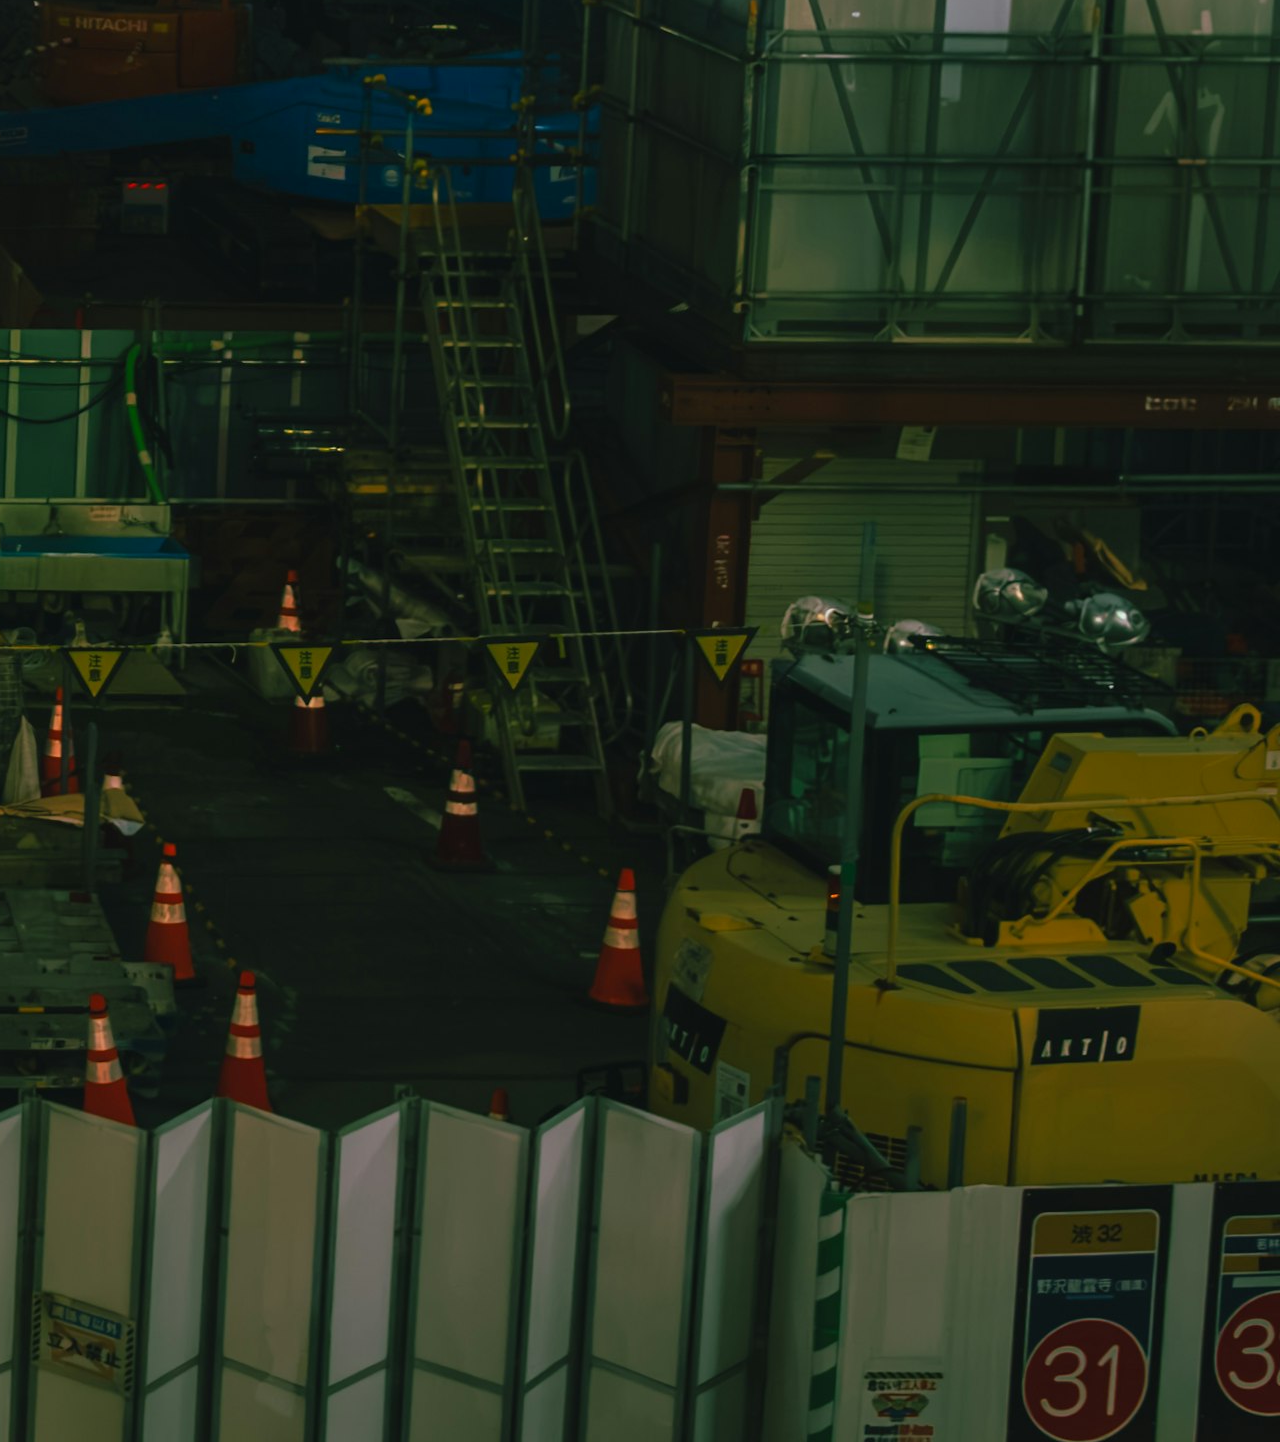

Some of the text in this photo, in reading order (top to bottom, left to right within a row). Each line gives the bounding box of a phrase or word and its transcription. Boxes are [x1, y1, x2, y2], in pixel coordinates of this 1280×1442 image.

[75, 17, 148, 33] HITACHI
[1072, 1224, 1122, 1244] 渋 32
[1229, 1318, 1280, 1390] 3
[1041, 1346, 1119, 1417] 31
